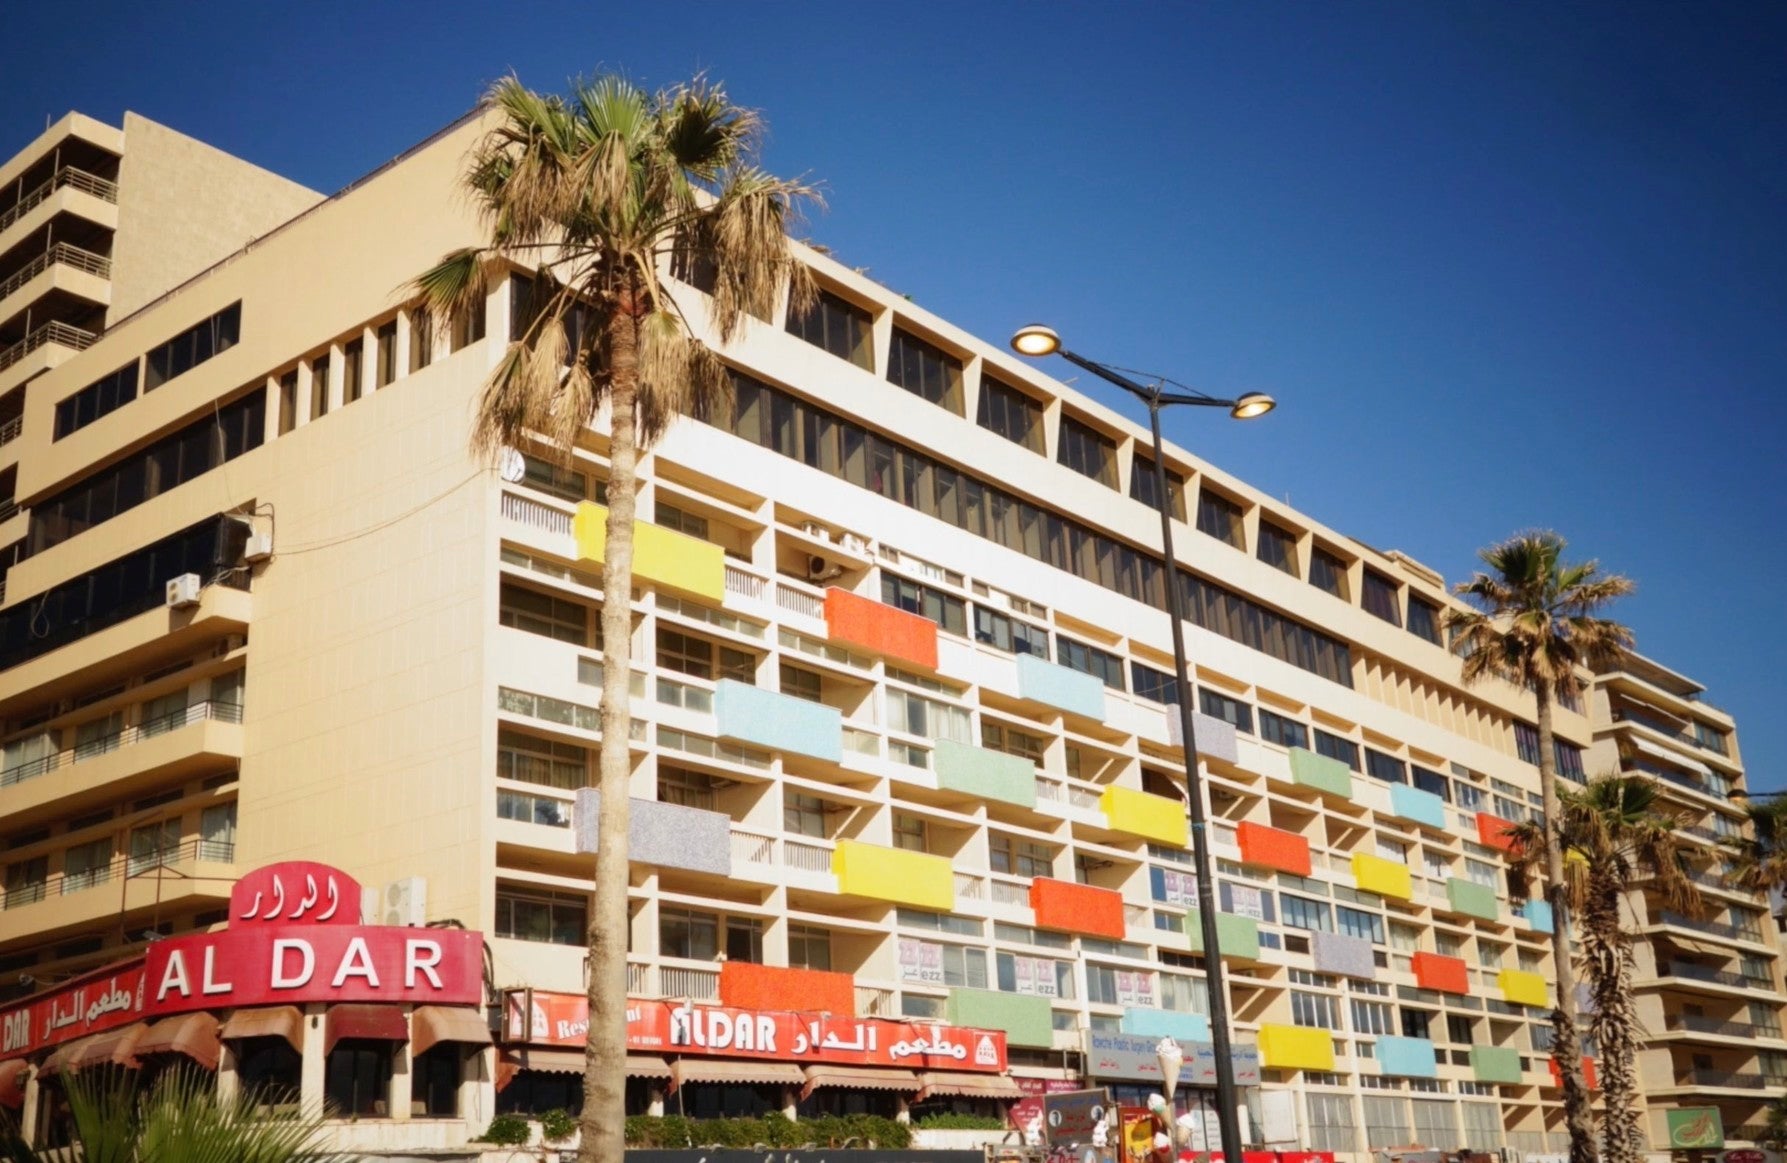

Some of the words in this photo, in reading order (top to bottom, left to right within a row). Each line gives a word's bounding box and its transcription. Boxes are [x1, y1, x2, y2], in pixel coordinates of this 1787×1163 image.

[240, 873, 339, 921] الدار
[157, 945, 233, 1001] AL
[271, 937, 444, 990] DAR
[43, 990, 84, 1040] الدار
[86, 976, 132, 1027] مطعم
[3, 1008, 30, 1053] DAR
[791, 1020, 877, 1054] الدار
[889, 1025, 967, 1061] مطعم
